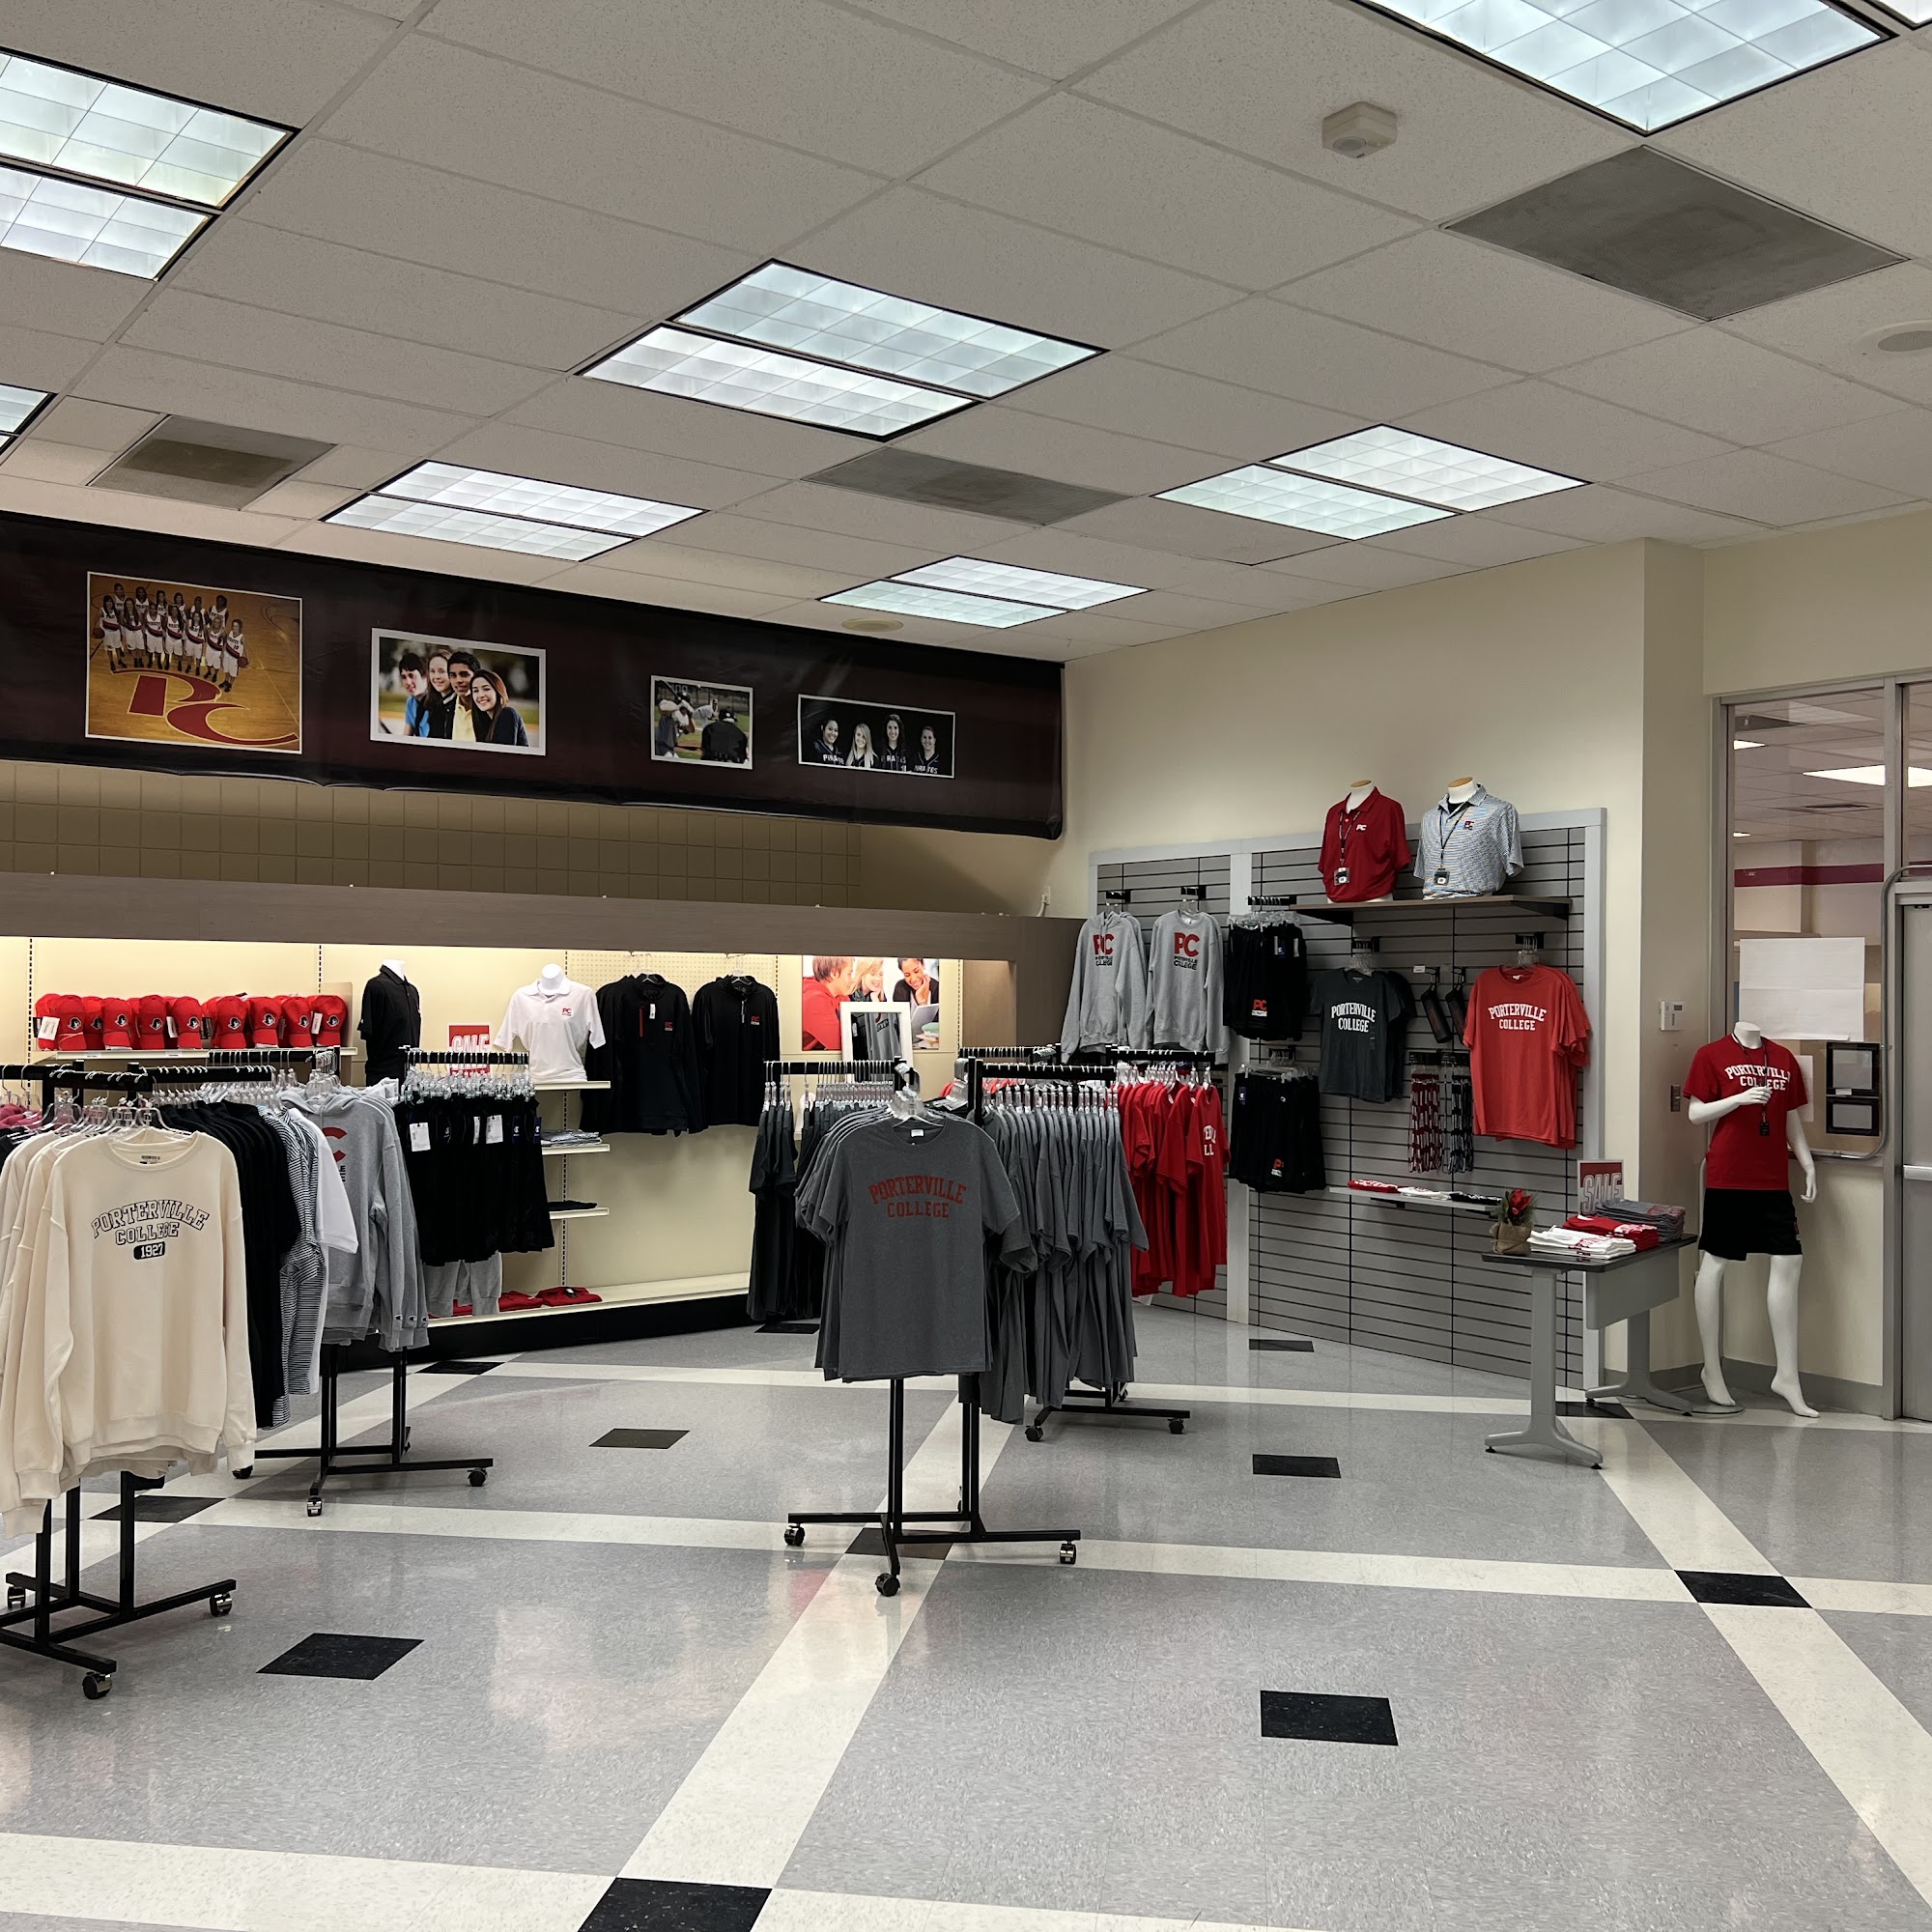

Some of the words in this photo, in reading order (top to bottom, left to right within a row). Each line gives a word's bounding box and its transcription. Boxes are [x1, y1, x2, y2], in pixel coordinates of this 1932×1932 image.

[1093, 933, 1115, 955] PC
[1174, 932, 1200, 957] PC
[1253, 999, 1267, 1011] PC
[1331, 1002, 1377, 1023] PORTERVILLE
[1489, 1004, 1547, 1022] PORTERVILLE
[1338, 1017, 1370, 1033] COLLEGE
[1499, 1019, 1536, 1031] COLLEGE
[1740, 1076, 1786, 1091] COLEGE
[867, 1175, 967, 1205] PORTERVILLE
[1581, 1172, 1622, 1215] SALE
[91, 1200, 211, 1238] PORTERVILLE
[887, 1201, 950, 1218] COLLEGE
[115, 1222, 180, 1245] COLLEGE
[140, 1243, 163, 1259] 1927
